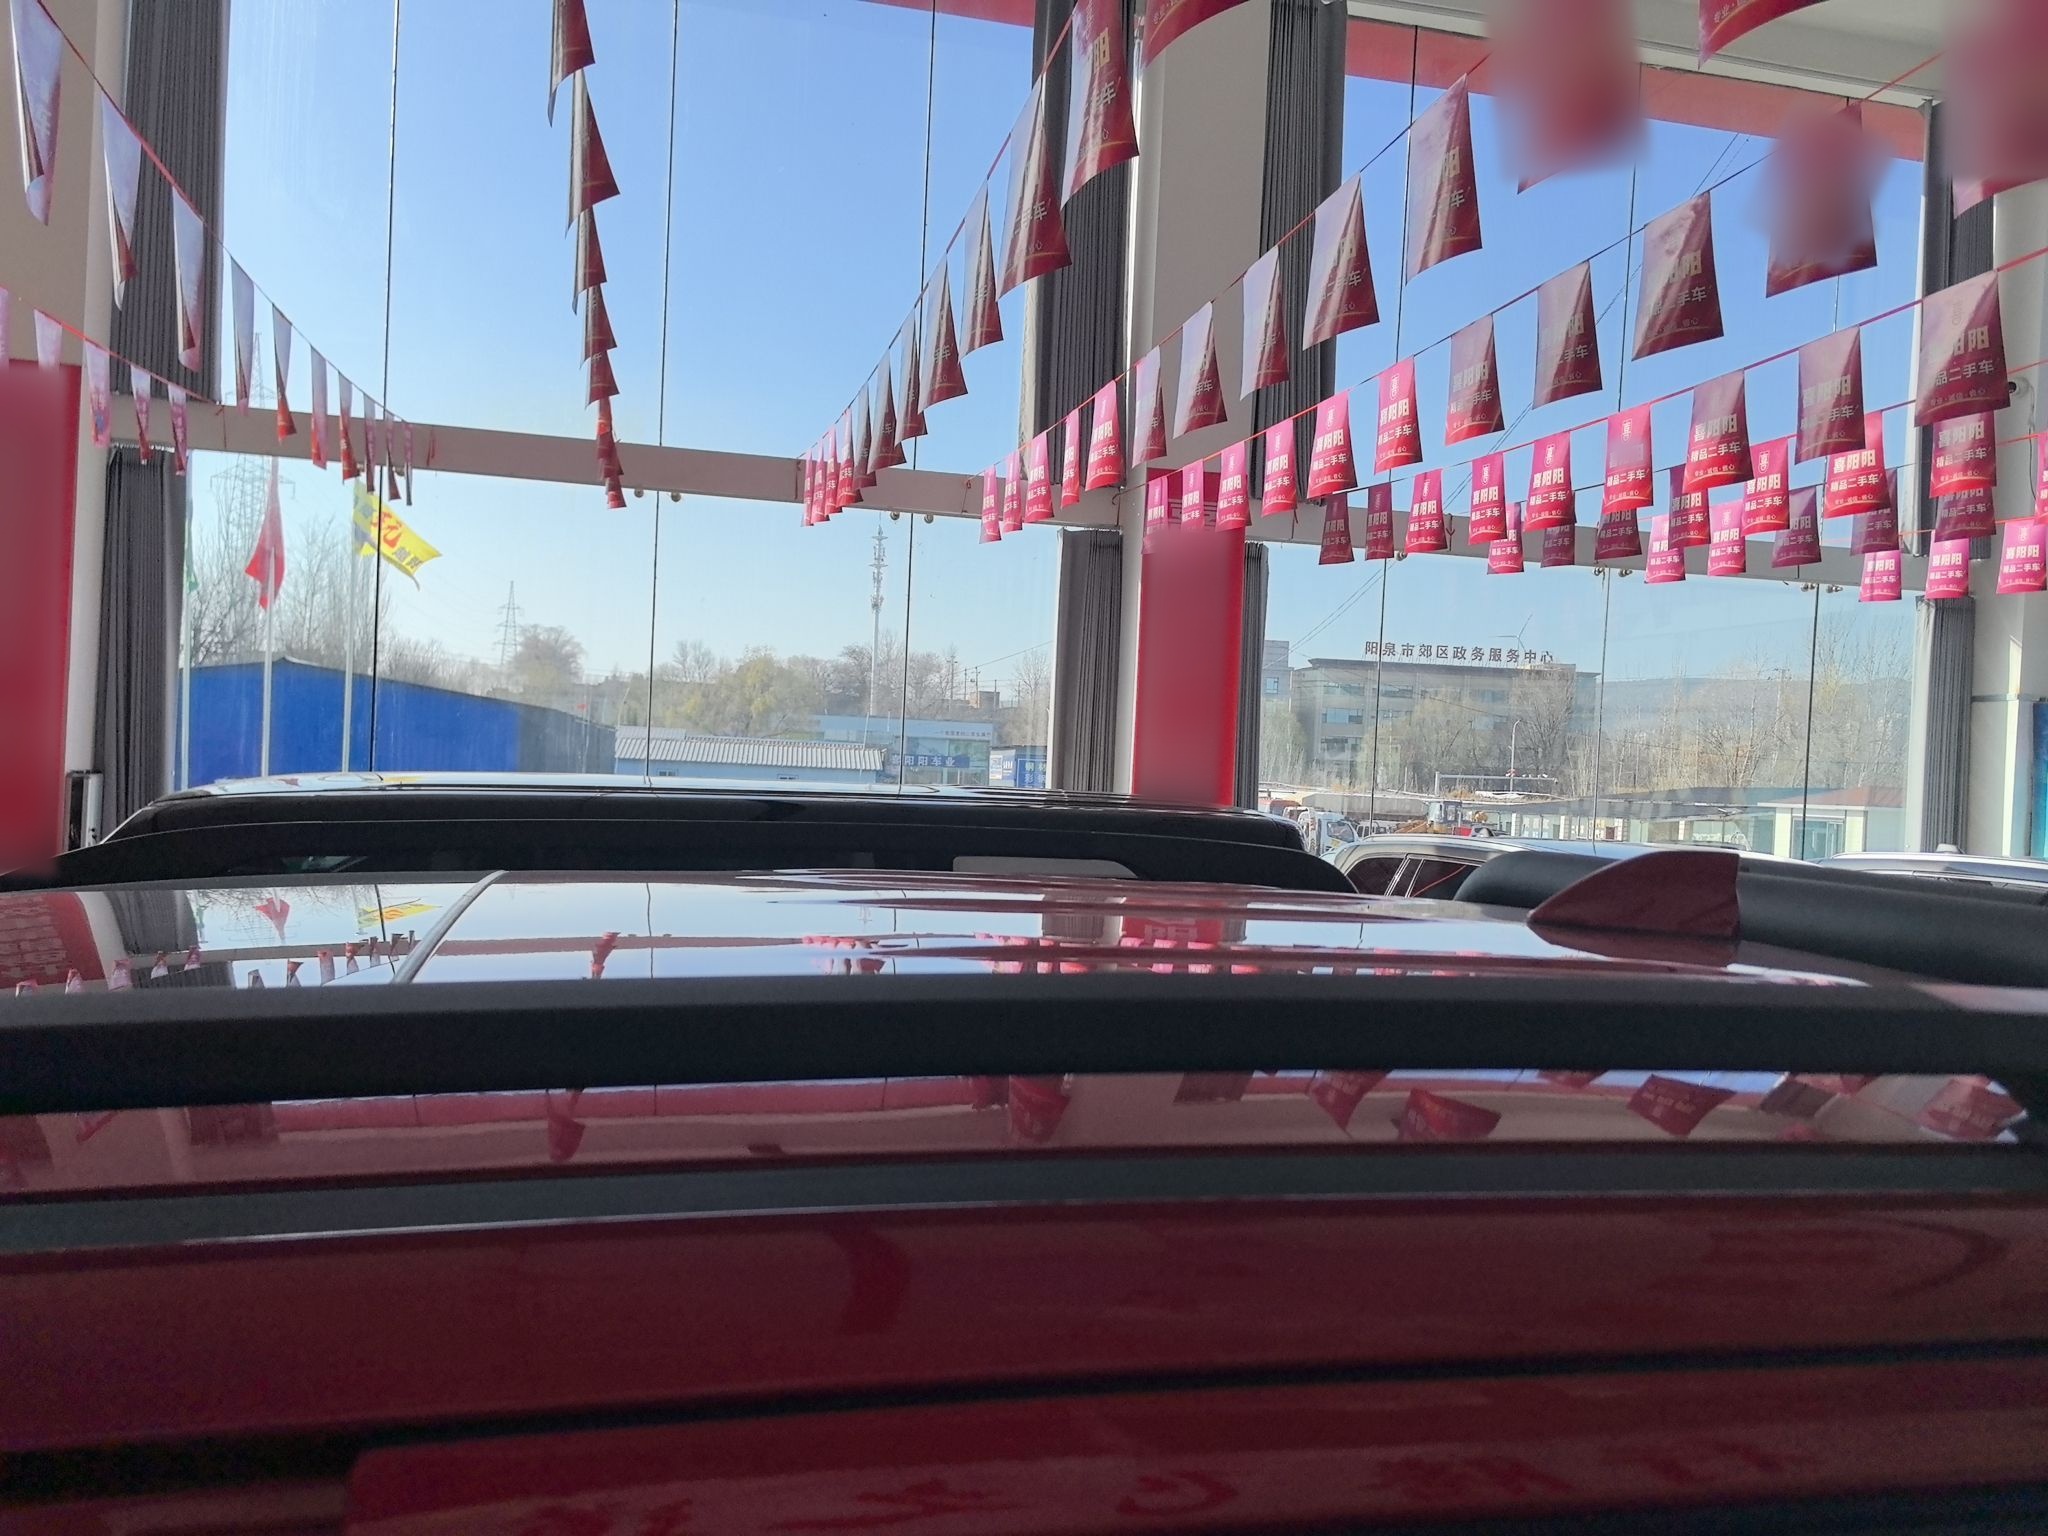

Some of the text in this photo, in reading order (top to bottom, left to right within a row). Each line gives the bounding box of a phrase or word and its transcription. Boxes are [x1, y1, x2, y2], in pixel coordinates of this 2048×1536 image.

[1936, 359, 1994, 386] 品二手车
[1380, 398, 1409, 426] 喜阳阳
[1694, 414, 1737, 441] 喜阳阳
[1939, 421, 1984, 448] 喜阳阳
[1316, 429, 1344, 453] 喜阳阳
[1691, 441, 1741, 462] 精品二手车
[1936, 447, 1987, 469] 精品二手车
[1833, 449, 1876, 474] 喜阳阳
[1533, 467, 1564, 489] 喜阳阳
[1607, 469, 1646, 488] 精品二手车
[1746, 474, 1781, 495] 喜阳阳
[1831, 474, 1879, 492] 精品二手车
[1472, 486, 1499, 506] 喜阳阳
[1530, 490, 1567, 506] 精品二手车
[1672, 492, 1701, 511] 喜阳阳
[1745, 496, 1782, 512] 精品二手车
[1412, 500, 1437, 517] 喜阳阳
[1472, 507, 1500, 521] 精品二手车
[1671, 513, 1704, 527] 精品二手车
[1713, 528, 1739, 542] 喜阳阳
[1651, 556, 1680, 566] 精品二手车
[1712, 546, 1740, 558] 精品二手车
[1932, 553, 1962, 566] 喜阳阳
[2005, 545, 2040, 560] 喜阳阳
[1867, 559, 1895, 571] 喜阳阳
[2002, 563, 2041, 574] 精品二手车
[1865, 575, 1896, 584] 精品二手车
[1929, 569, 1963, 580] 精品二手车
[1365, 641, 1553, 664] 阳泉市郊区政务服务中心
